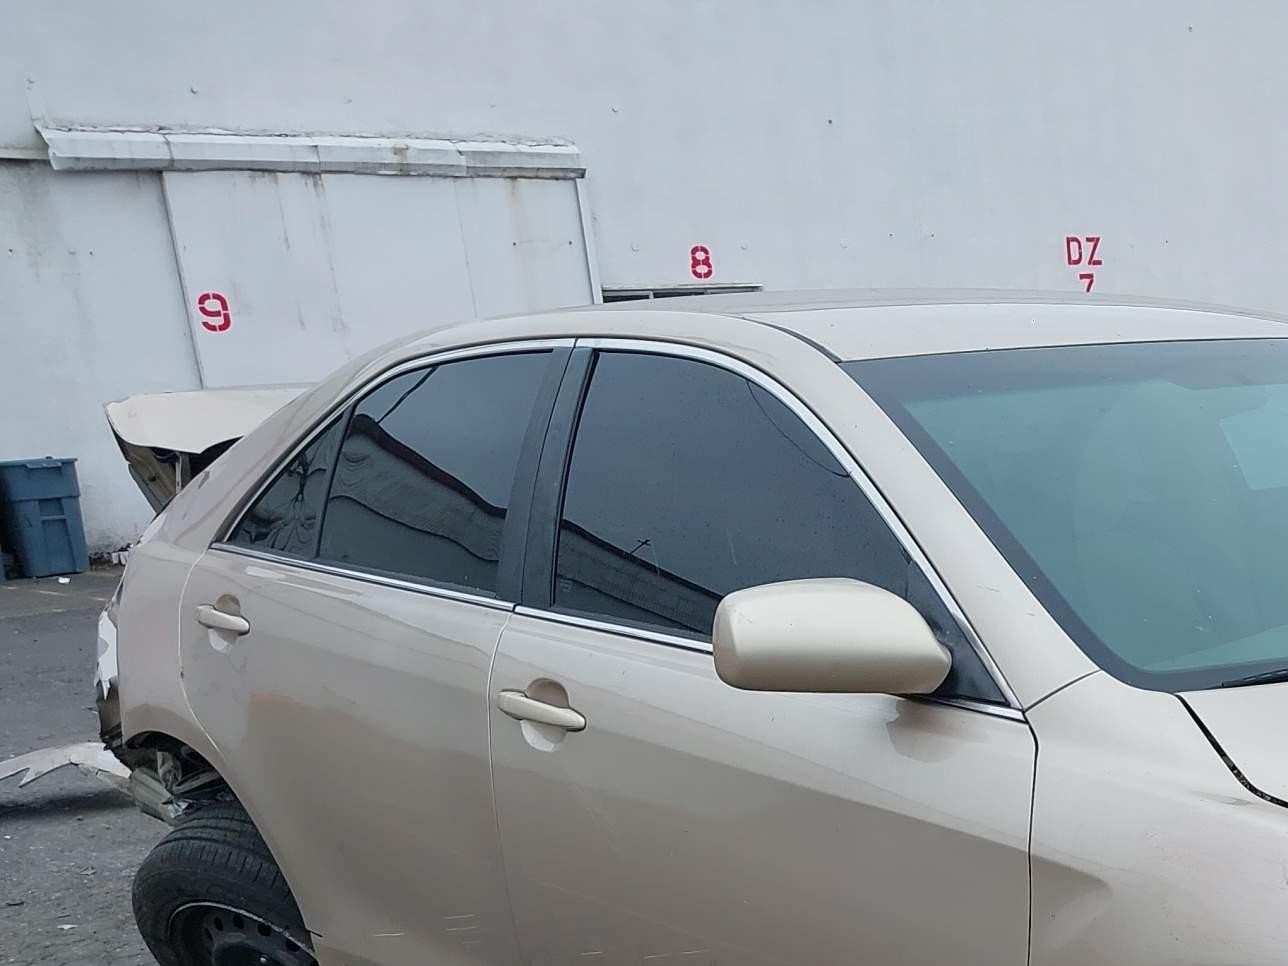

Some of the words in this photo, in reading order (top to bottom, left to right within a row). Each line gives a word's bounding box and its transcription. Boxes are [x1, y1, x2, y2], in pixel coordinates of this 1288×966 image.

[690, 245, 713, 279] 8
[1065, 236, 1103, 266] DZ
[1079, 273, 1095, 293] 7
[197, 292, 232, 332] 9
